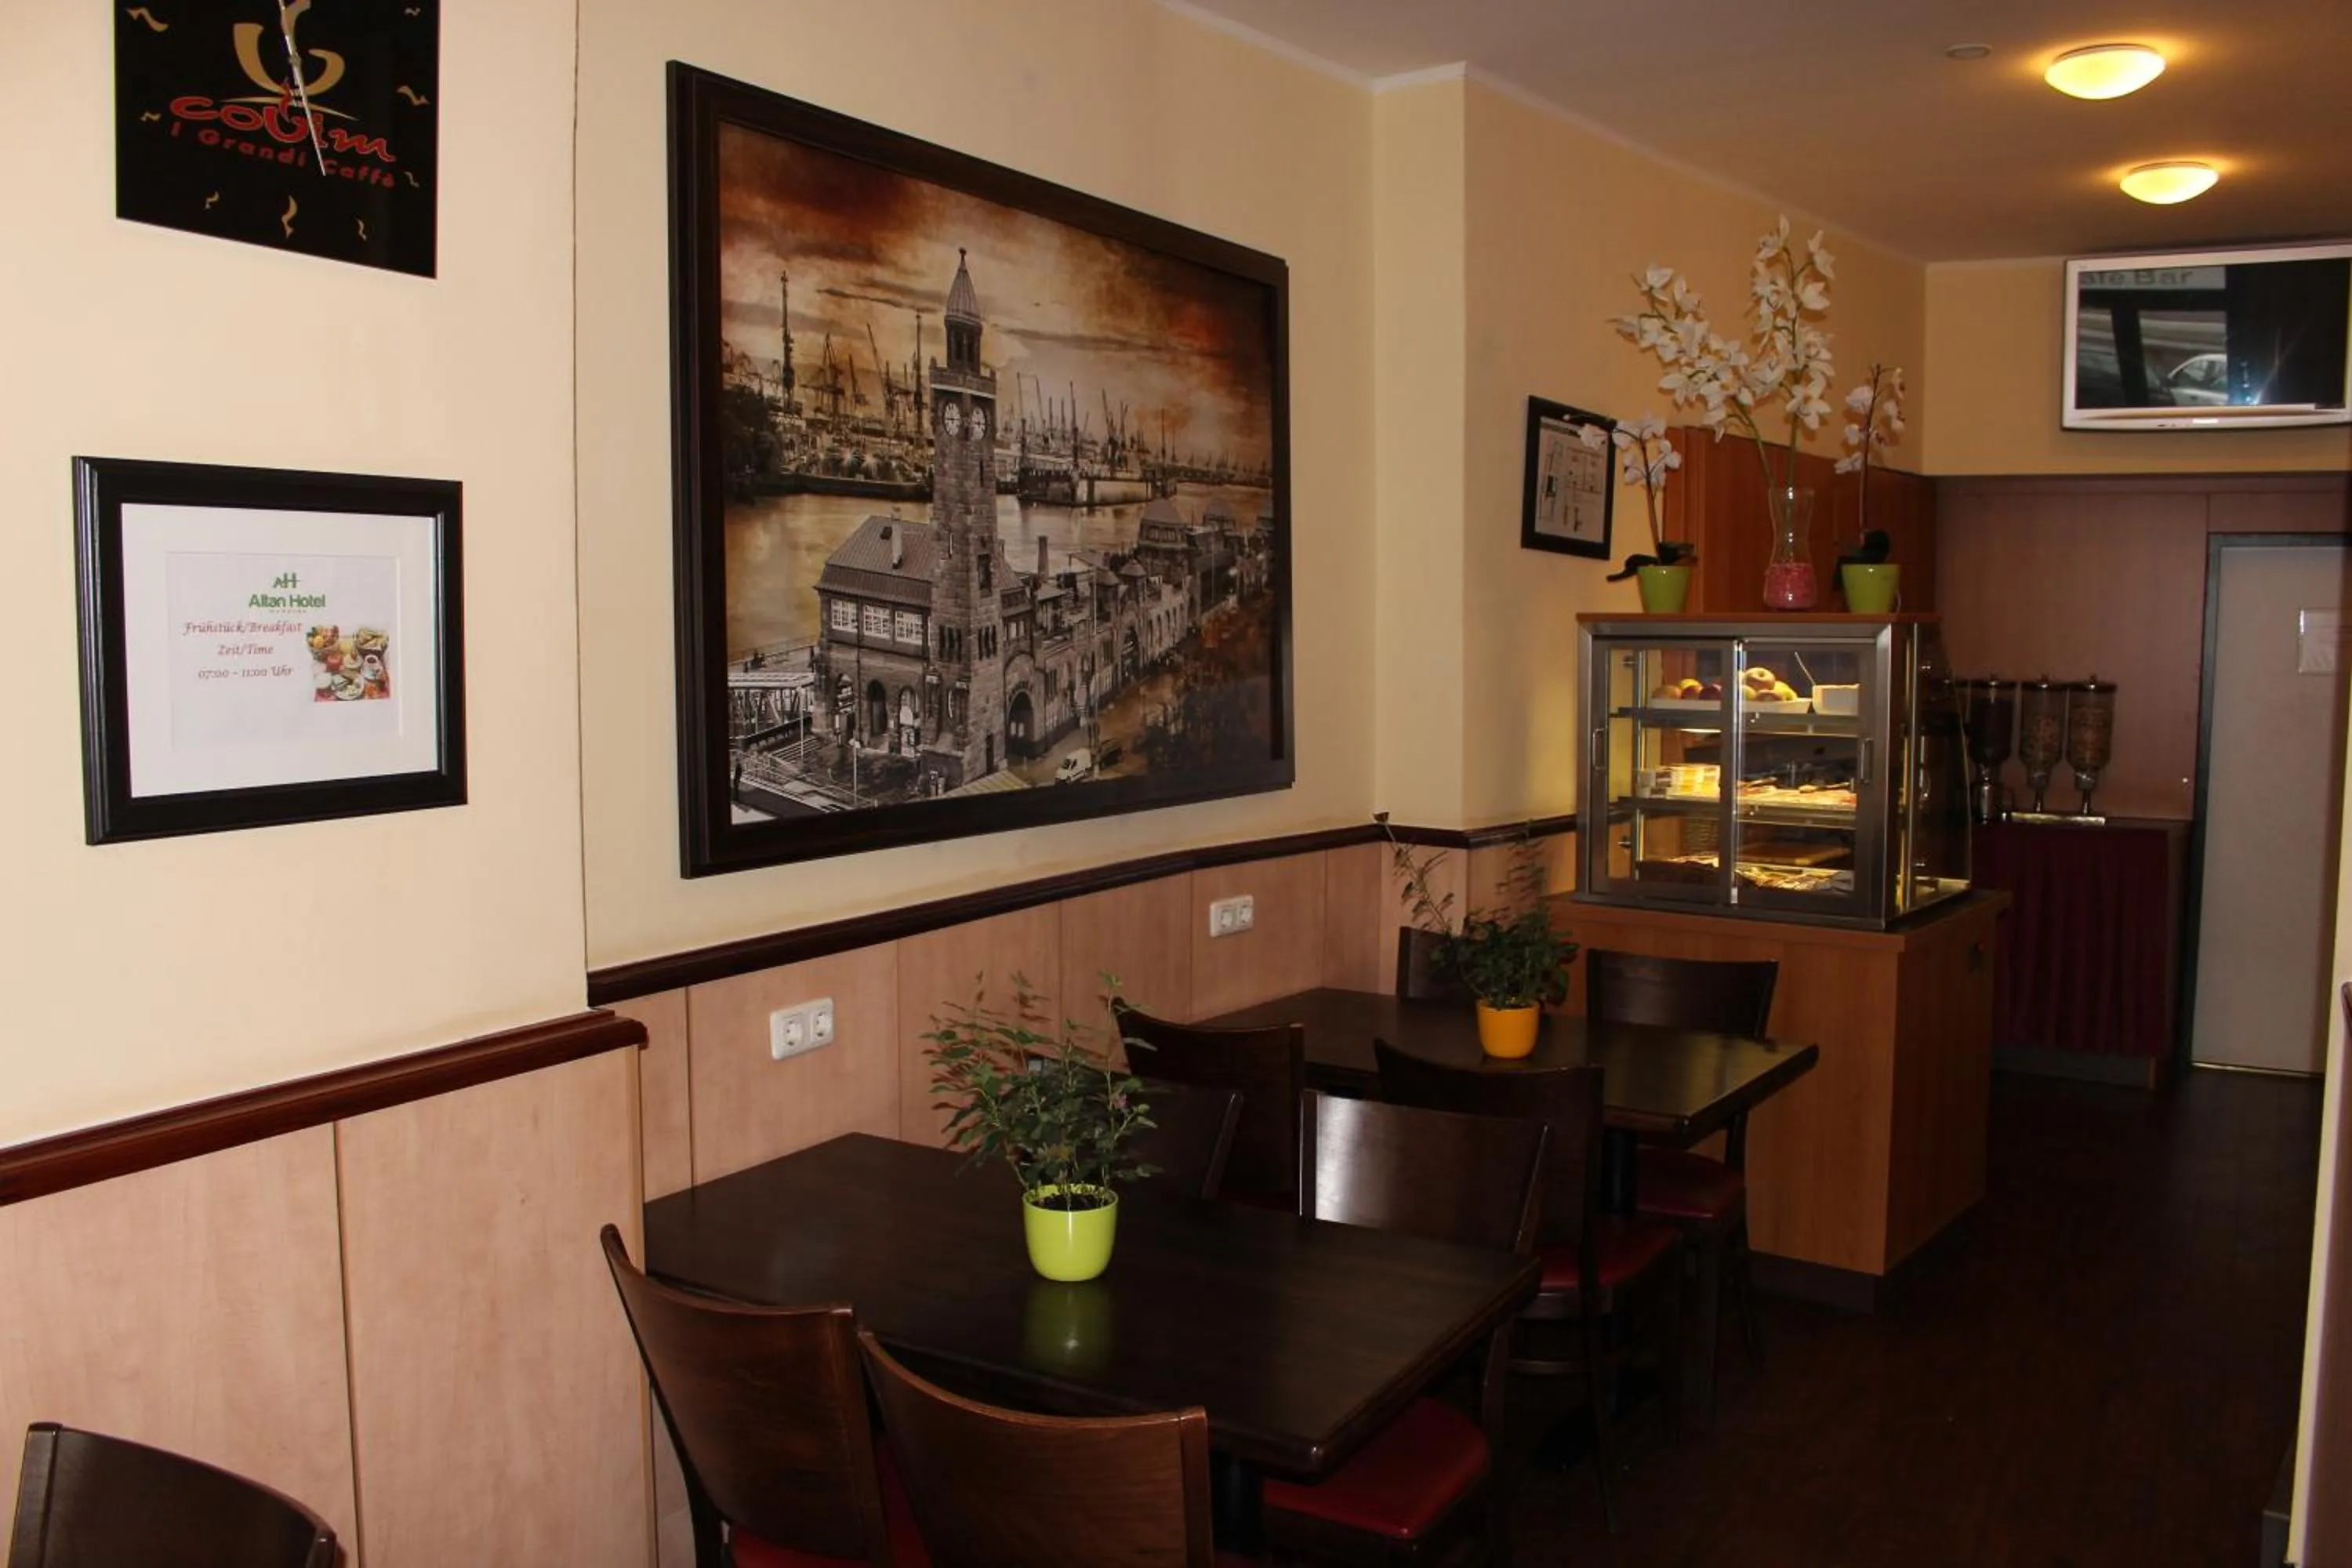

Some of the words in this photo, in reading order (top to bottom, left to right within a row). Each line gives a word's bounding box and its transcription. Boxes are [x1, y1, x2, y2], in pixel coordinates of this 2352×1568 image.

[198, 129, 307, 168] Grandi
[249, 593, 286, 608] Altan
[289, 593, 326, 608] Hotel
[270, 664, 293, 677] Uhr
